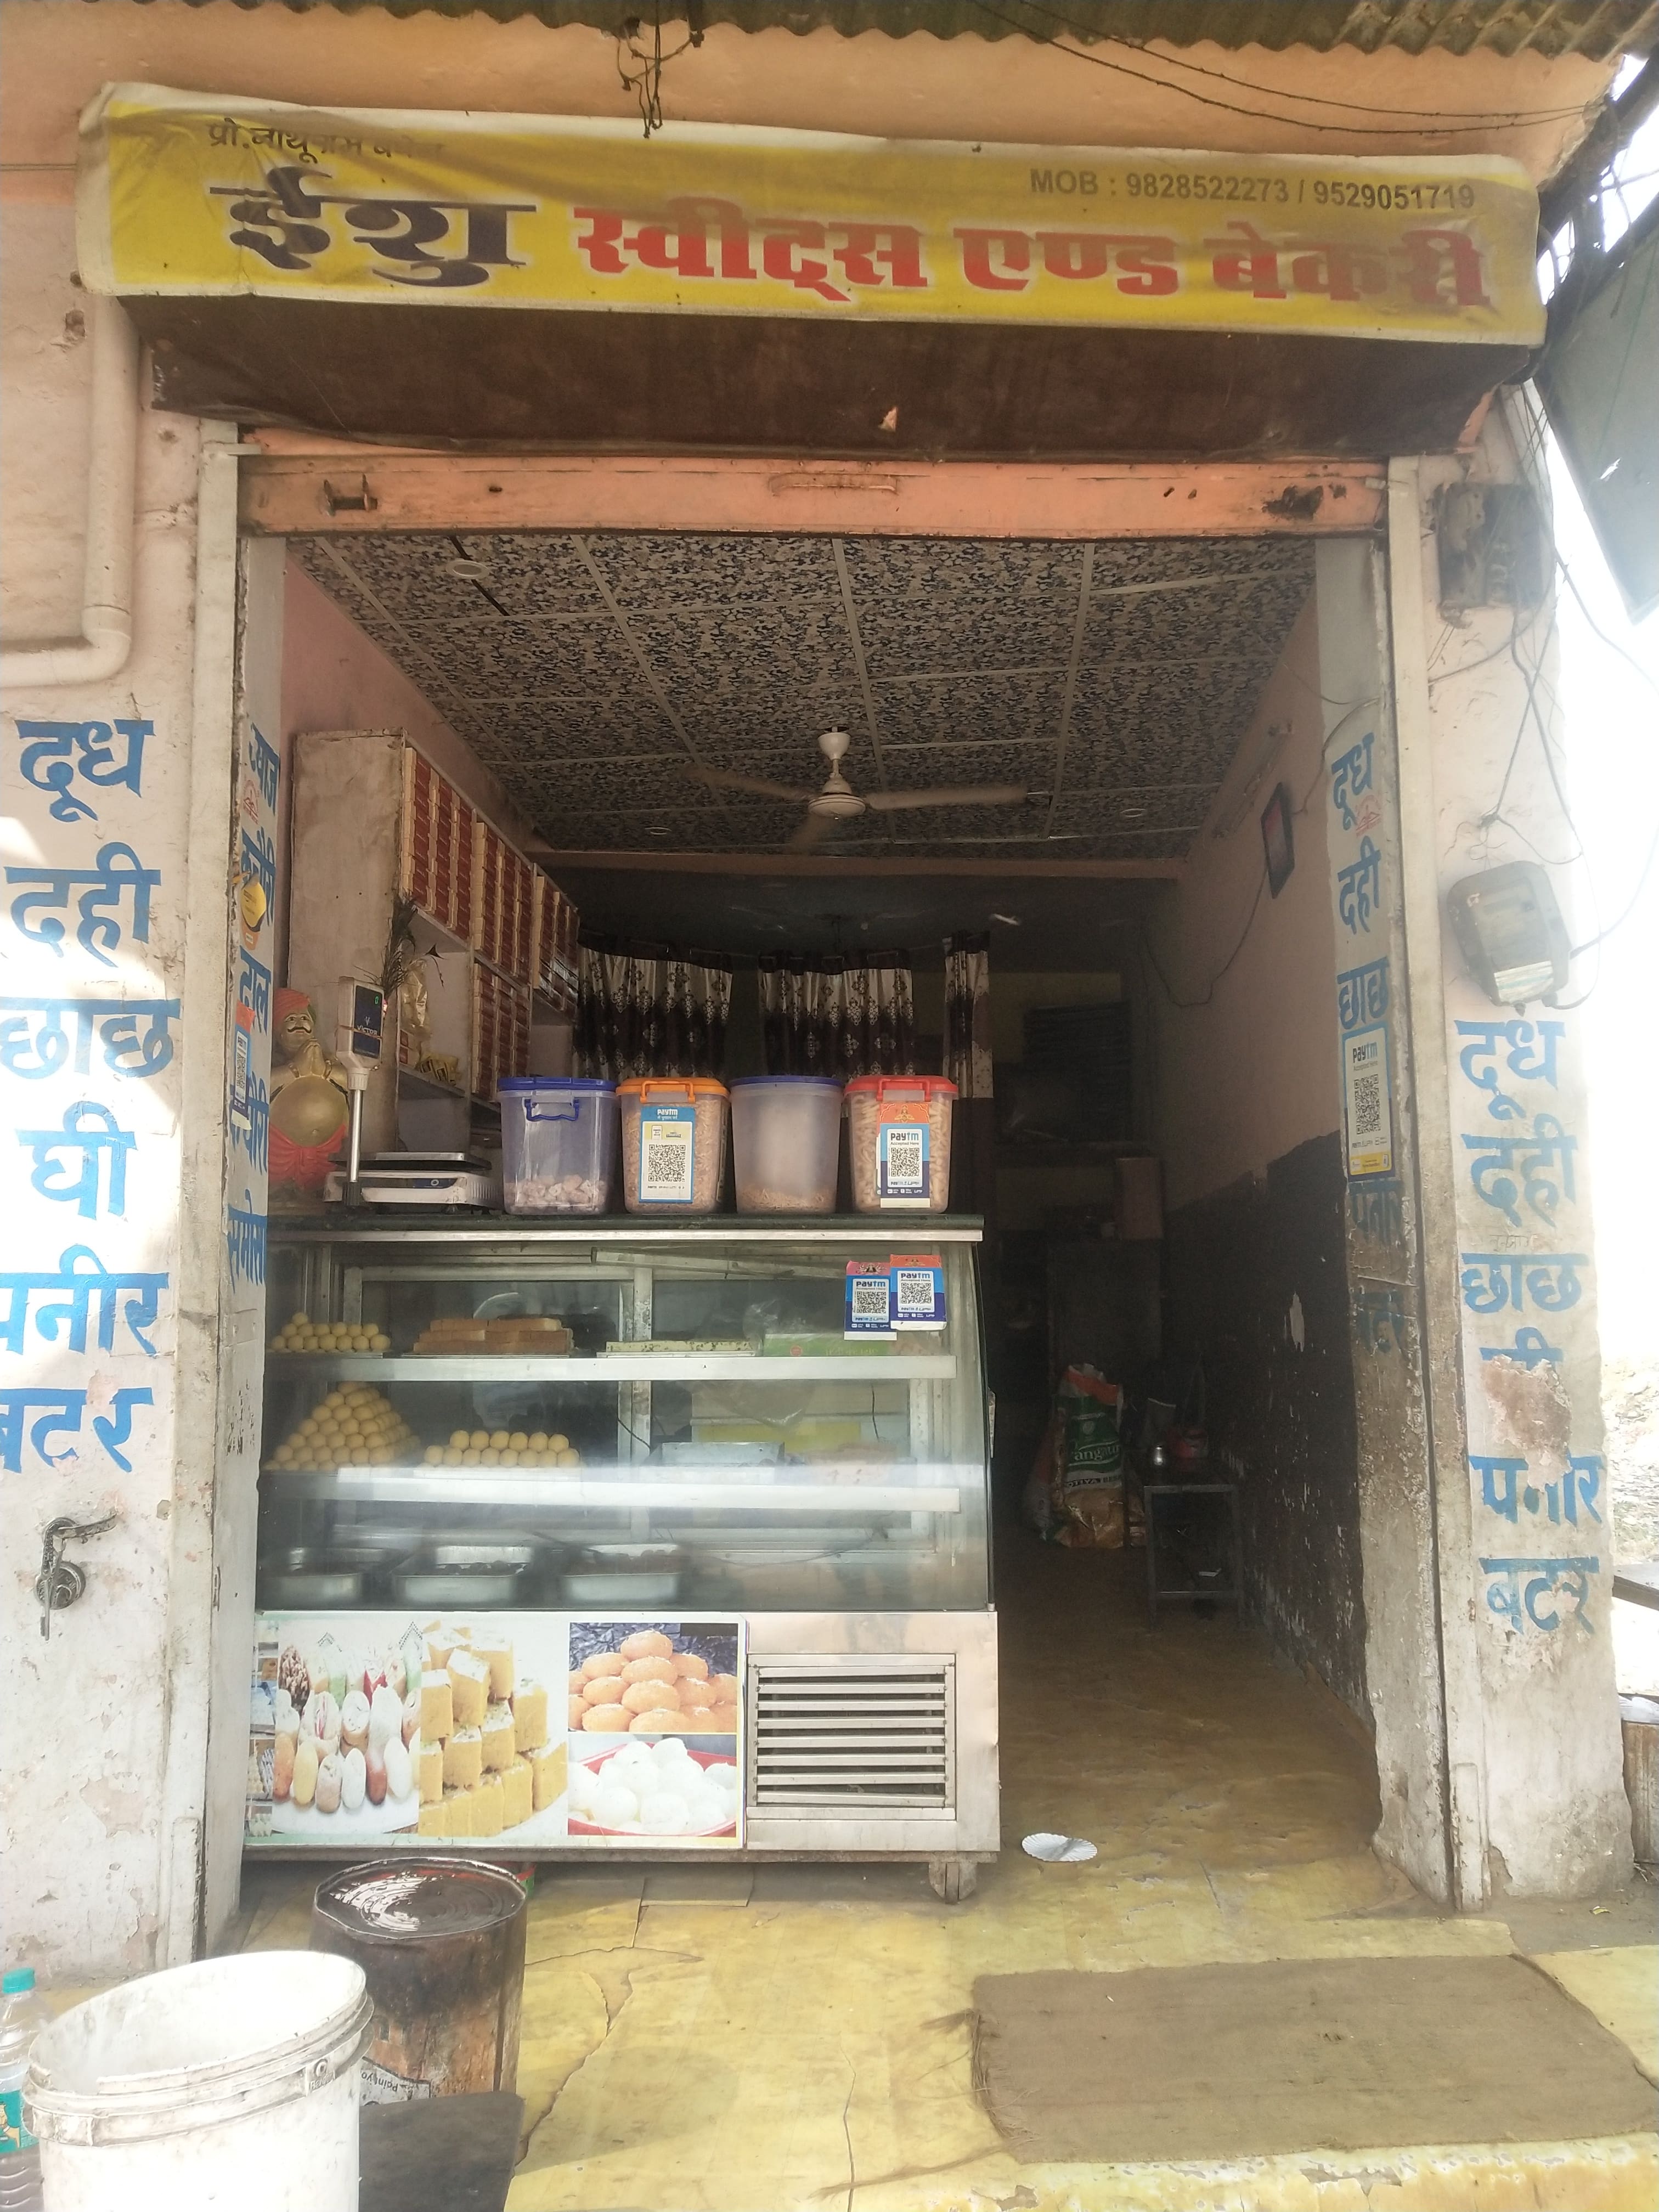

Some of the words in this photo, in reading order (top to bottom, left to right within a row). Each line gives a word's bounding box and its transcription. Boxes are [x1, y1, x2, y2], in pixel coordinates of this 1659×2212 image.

[210, 167, 536, 287] ईशु
[574, 196, 928, 301] स्वीट्स
[954, 228, 1178, 295] एण्ड
[1204, 221, 1491, 306] बेकरी
[1030, 168, 1097, 195] MOB
[1126, 172, 1289, 203] 9828522273
[1315, 180, 1475, 210] 9529051719
[15, 719, 156, 822] दूध
[1331, 732, 1374, 830] दूध
[4, 842, 161, 968] दही
[1338, 835, 1381, 935] दही
[0, 997, 180, 1080] छाछ
[357, 1025, 378, 1035] VICTOR
[1336, 956, 1391, 1030] छाछ
[1454, 1019, 1566, 1121] दूध
[15, 1101, 138, 1221] घी
[1460, 1113, 1578, 1228] दही
[1460, 1252, 1589, 1314] छाछ
